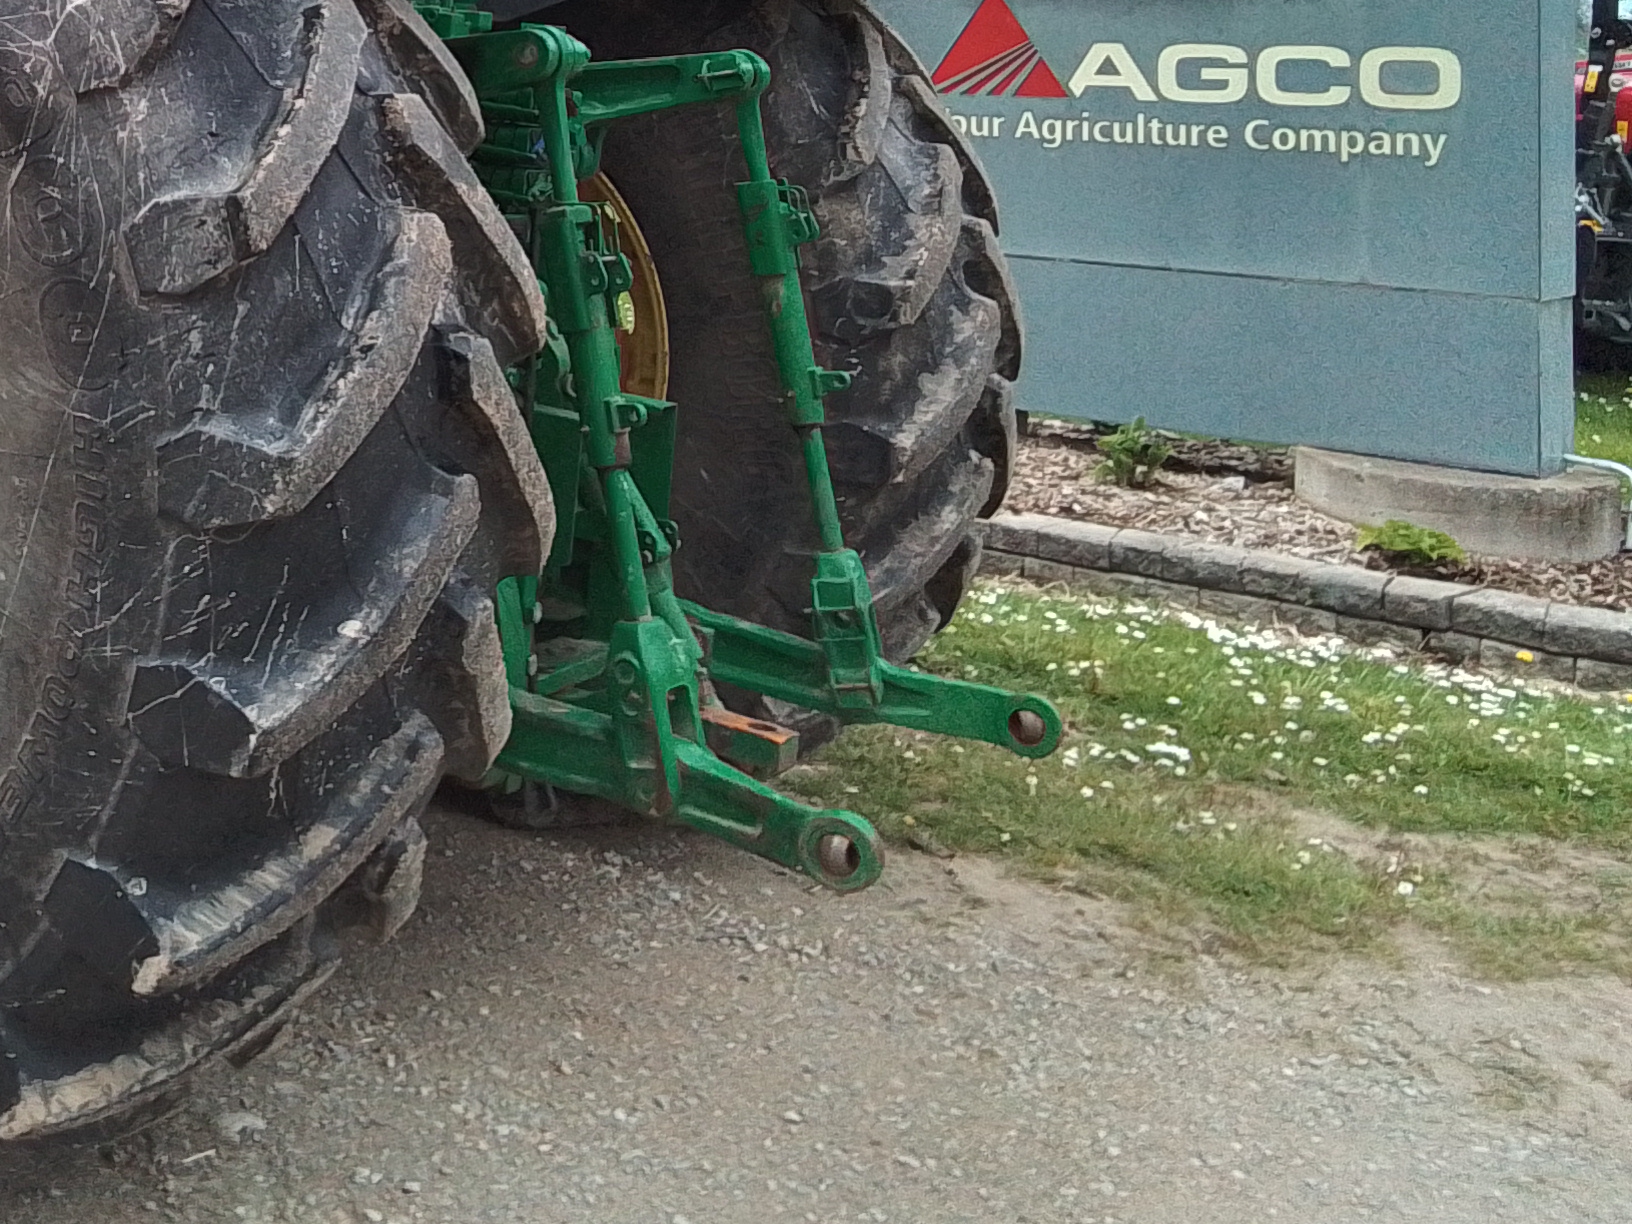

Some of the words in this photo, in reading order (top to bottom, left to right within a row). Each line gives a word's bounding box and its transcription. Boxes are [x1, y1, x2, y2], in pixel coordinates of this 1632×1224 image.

[1068, 42, 1463, 111] AGCO
[945, 108, 1005, 137] our
[1014, 110, 1229, 149] Agriculture
[1244, 119, 1449, 167] Company
